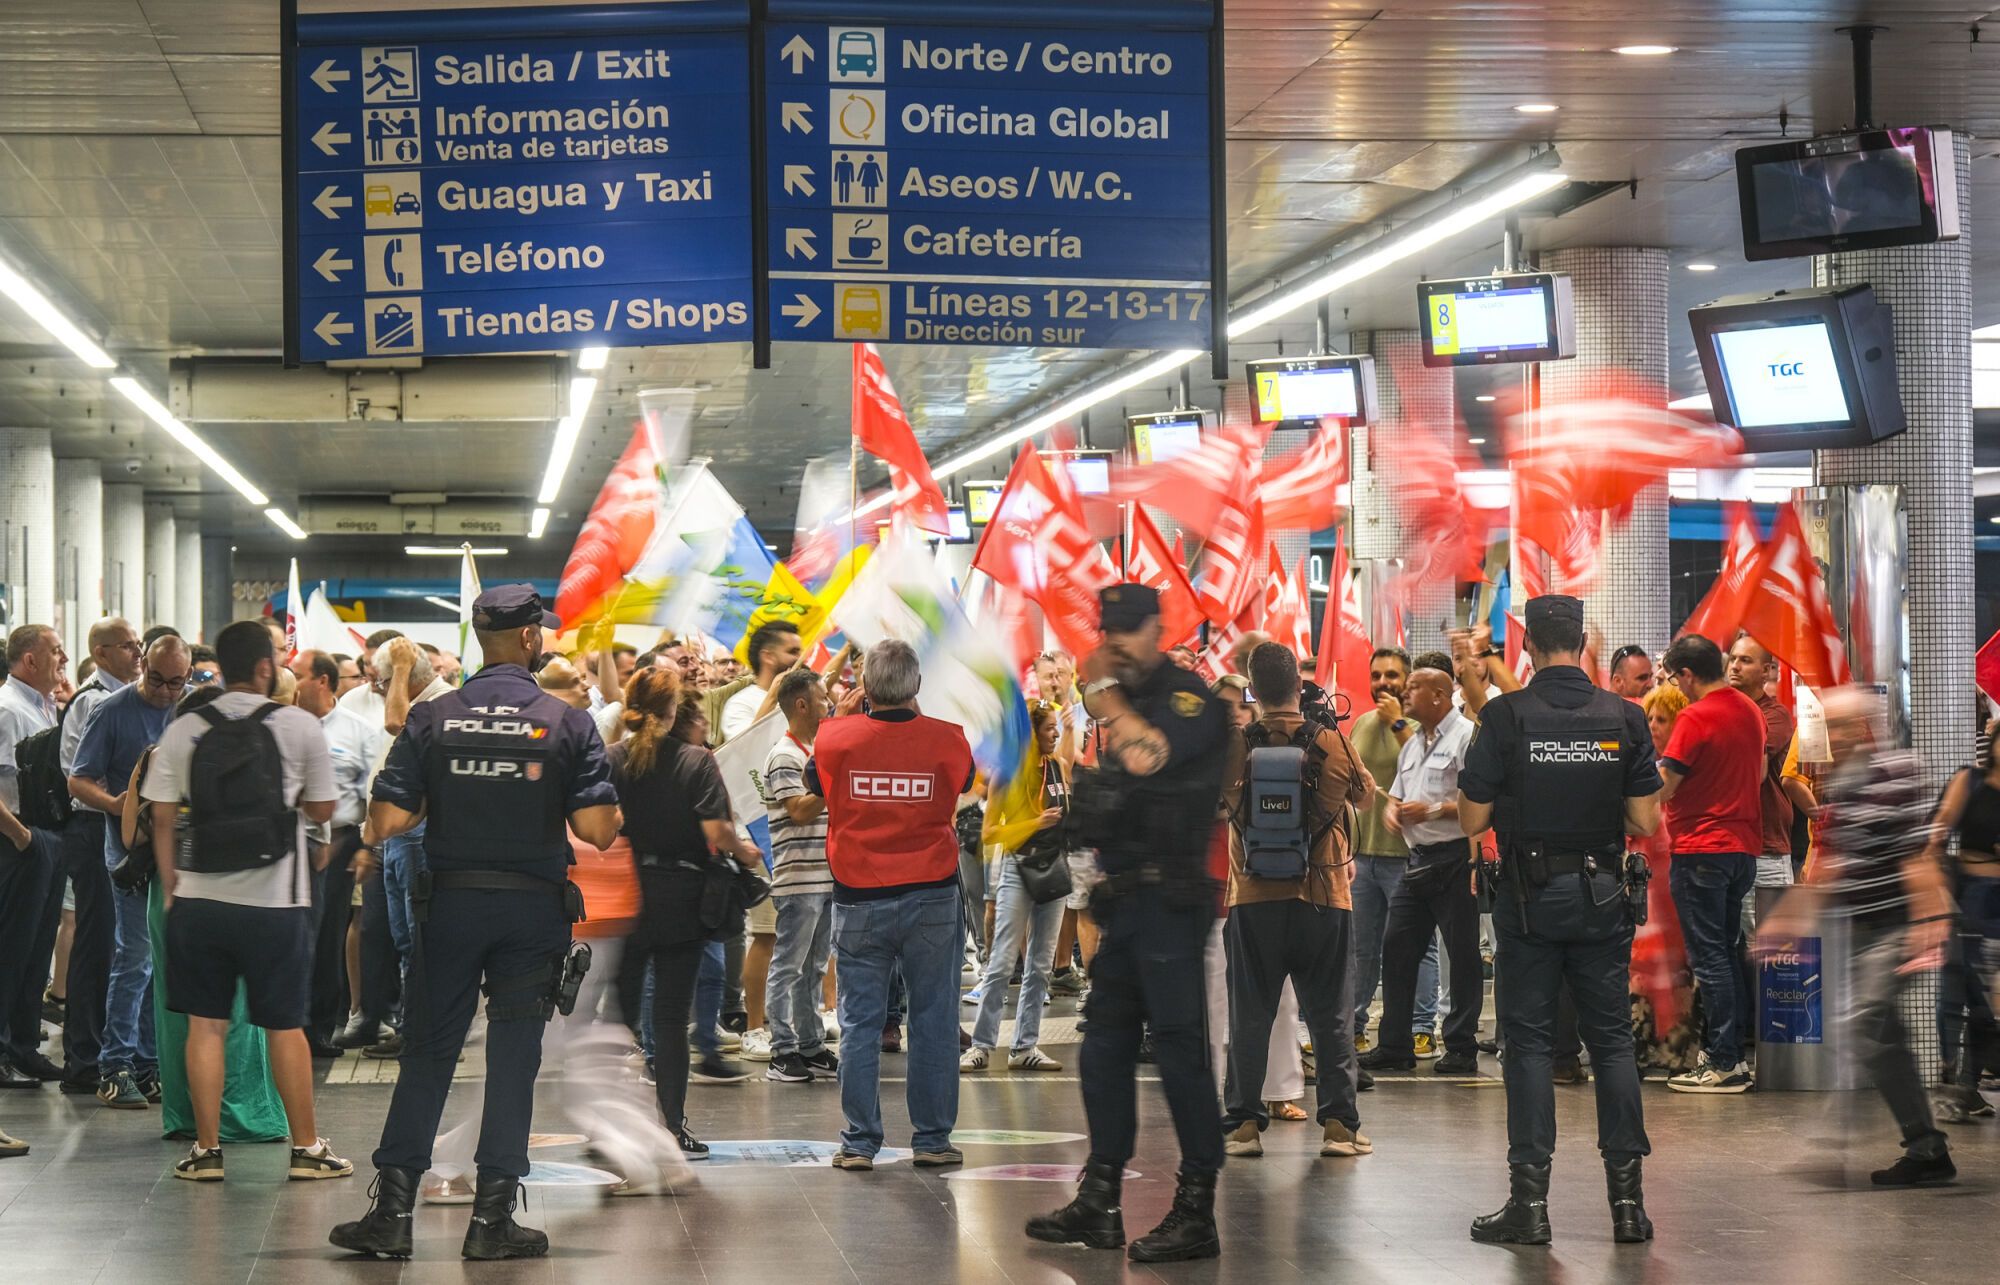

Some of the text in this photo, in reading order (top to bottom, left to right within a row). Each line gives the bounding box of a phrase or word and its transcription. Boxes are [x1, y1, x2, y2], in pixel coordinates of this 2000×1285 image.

[435, 50, 670, 84] Salida / Exit
[903, 40, 1171, 75] Norte / Centro
[437, 99, 668, 136] Información
[902, 104, 1168, 138] Oficina Global
[436, 136, 668, 160] Venta de tarjetas
[438, 171, 711, 214] Guagua y Taxi
[900, 167, 1131, 200] Aseos / W.C.
[904, 225, 1081, 258] Cafetería
[437, 242, 604, 274] Teléfono
[907, 286, 1206, 321] Líneas 12-13-17
[1438, 303, 1450, 326] 8
[438, 298, 747, 340] Tiendas / Shops
[906, 320, 1085, 342] Dirección sur
[1768, 363, 1804, 376] TGC
[1264, 380, 1273, 398] 7
[443, 720, 534, 735] POLICIA
[1530, 741, 1602, 751] POLICIA
[1530, 752, 1619, 762] NACIONAL
[853, 777, 930, 797] CCOO
[1262, 800, 1289, 810] LiveU
[1776, 954, 1800, 965] TGC
[1766, 988, 1806, 1000] Reciclar
